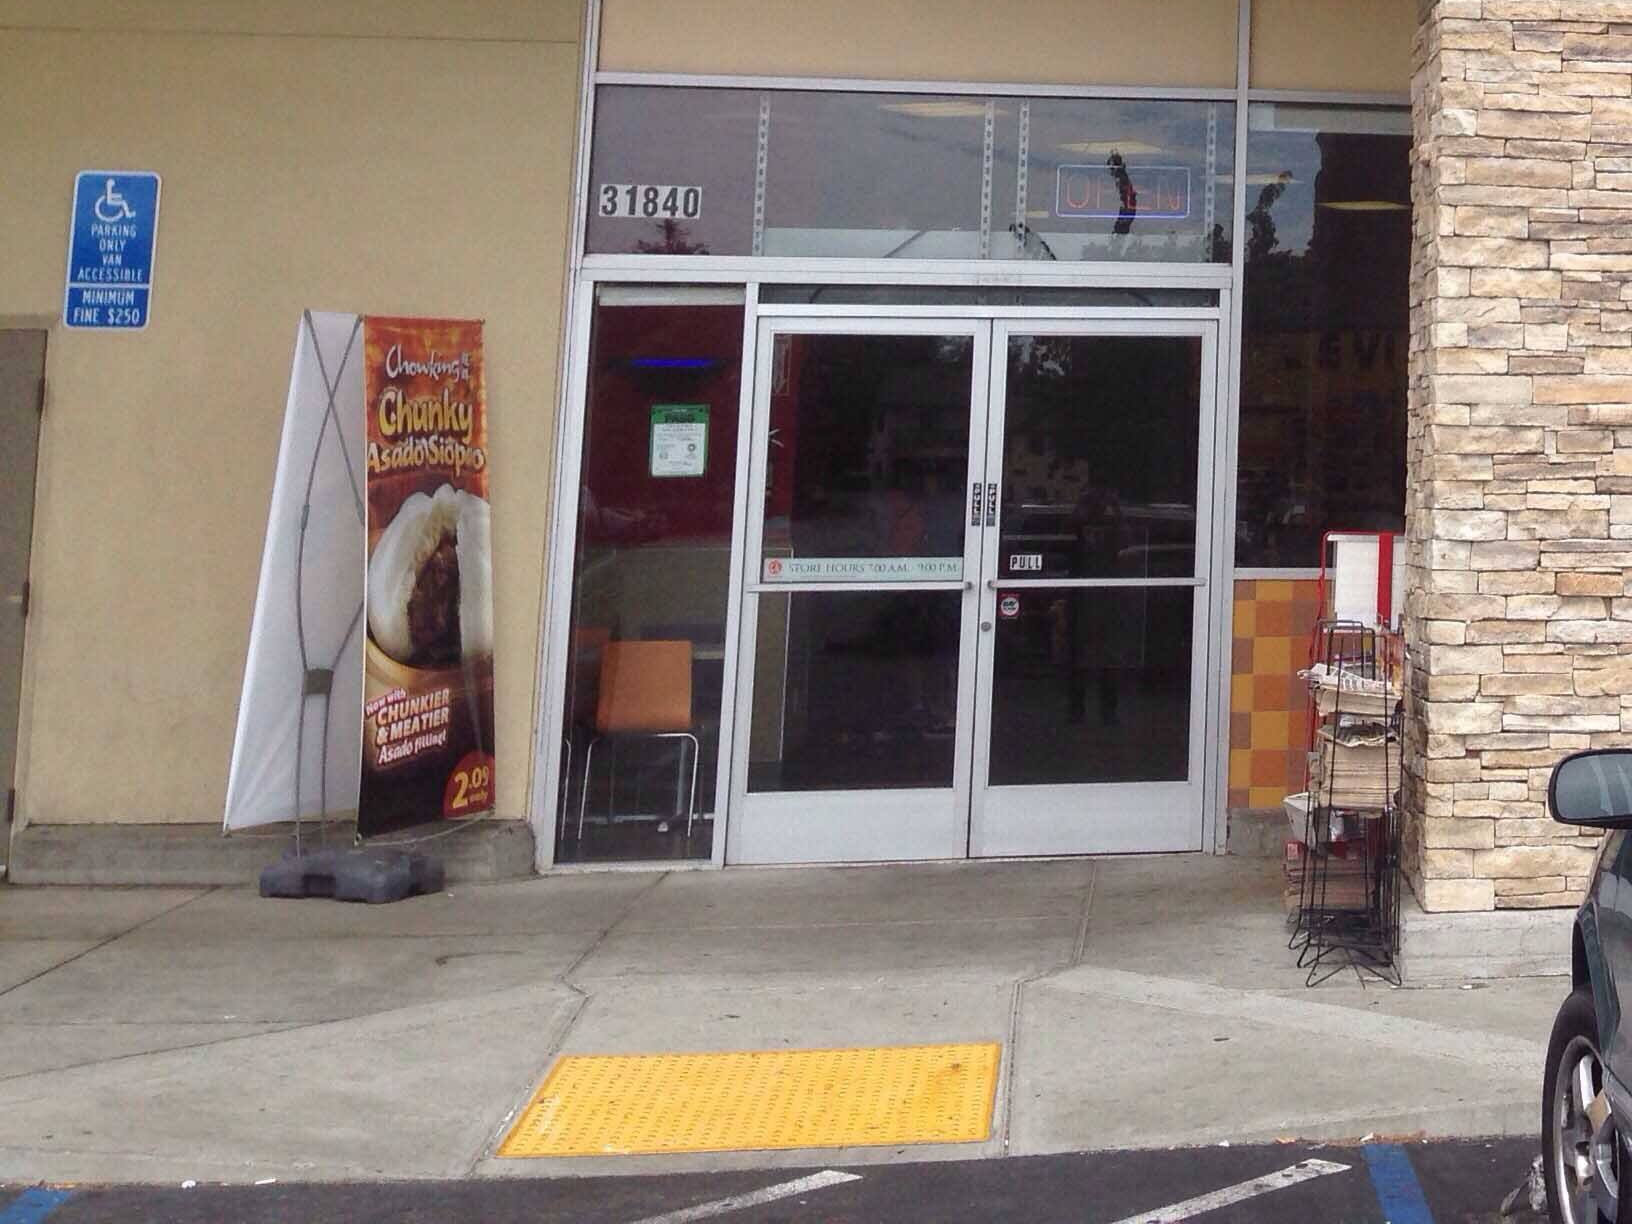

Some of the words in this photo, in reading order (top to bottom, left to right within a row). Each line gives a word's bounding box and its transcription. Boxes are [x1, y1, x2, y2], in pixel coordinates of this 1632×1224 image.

[602, 185, 700, 217] 31840
[91, 224, 136, 238] PARKING
[99, 239, 127, 251] ONLY
[102, 253, 122, 266] VAN
[77, 268, 143, 282] ACCESSIBLE
[82, 289, 135, 306] MINIMUM
[73, 308, 99, 323] FINE
[108, 309, 140, 324] $250
[386, 344, 460, 383] Chowking
[379, 388, 473, 444] Chunky
[367, 436, 424, 473] Asado
[825, 561, 865, 574] HOURS
[1011, 557, 1042, 569] PULL
[366, 697, 386, 716] Now
[387, 688, 406, 703] with
[377, 688, 450, 725] CHUNKIER
[376, 726, 388, 746] &
[390, 707, 450, 742] MEATIER
[378, 740, 413, 764] Asado
[452, 765, 489, 809] 2.09
